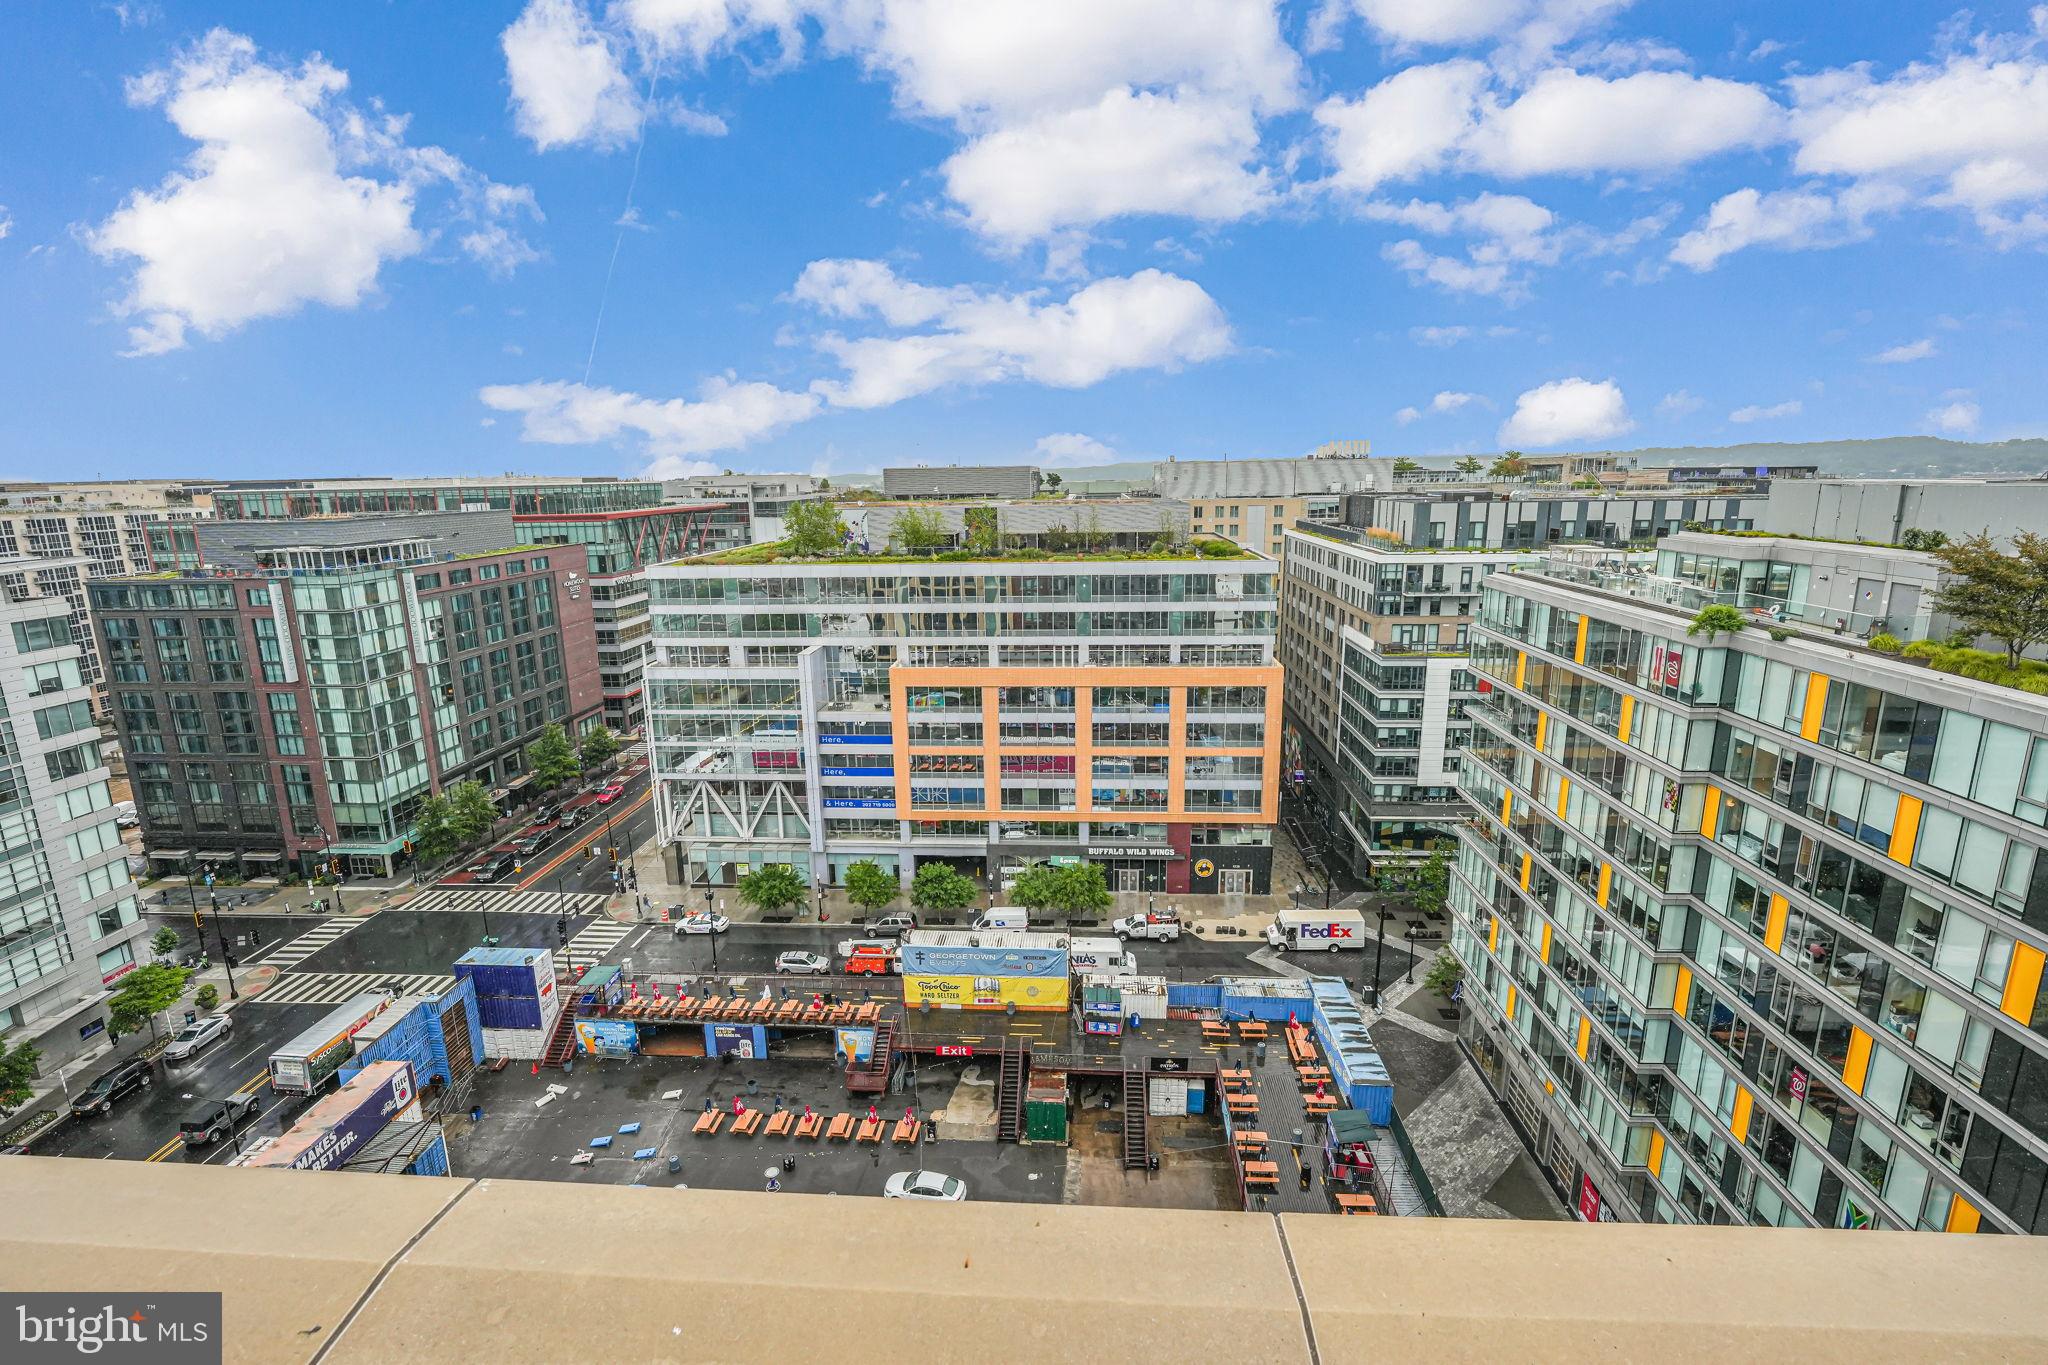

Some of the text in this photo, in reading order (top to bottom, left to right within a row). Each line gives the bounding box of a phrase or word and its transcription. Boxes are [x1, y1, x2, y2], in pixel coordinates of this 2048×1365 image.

[821, 736, 844, 744] Here,
[1088, 847, 1175, 856] BUFFALO WILD WINGS
[1301, 923, 1352, 938] FedEx
[929, 952, 996, 961] GEORGETOWN
[942, 1046, 967, 1055] Exit
[394, 1074, 408, 1091] Lite
[295, 1130, 338, 1170] MAKES
[312, 1130, 358, 1171] BETTER.
